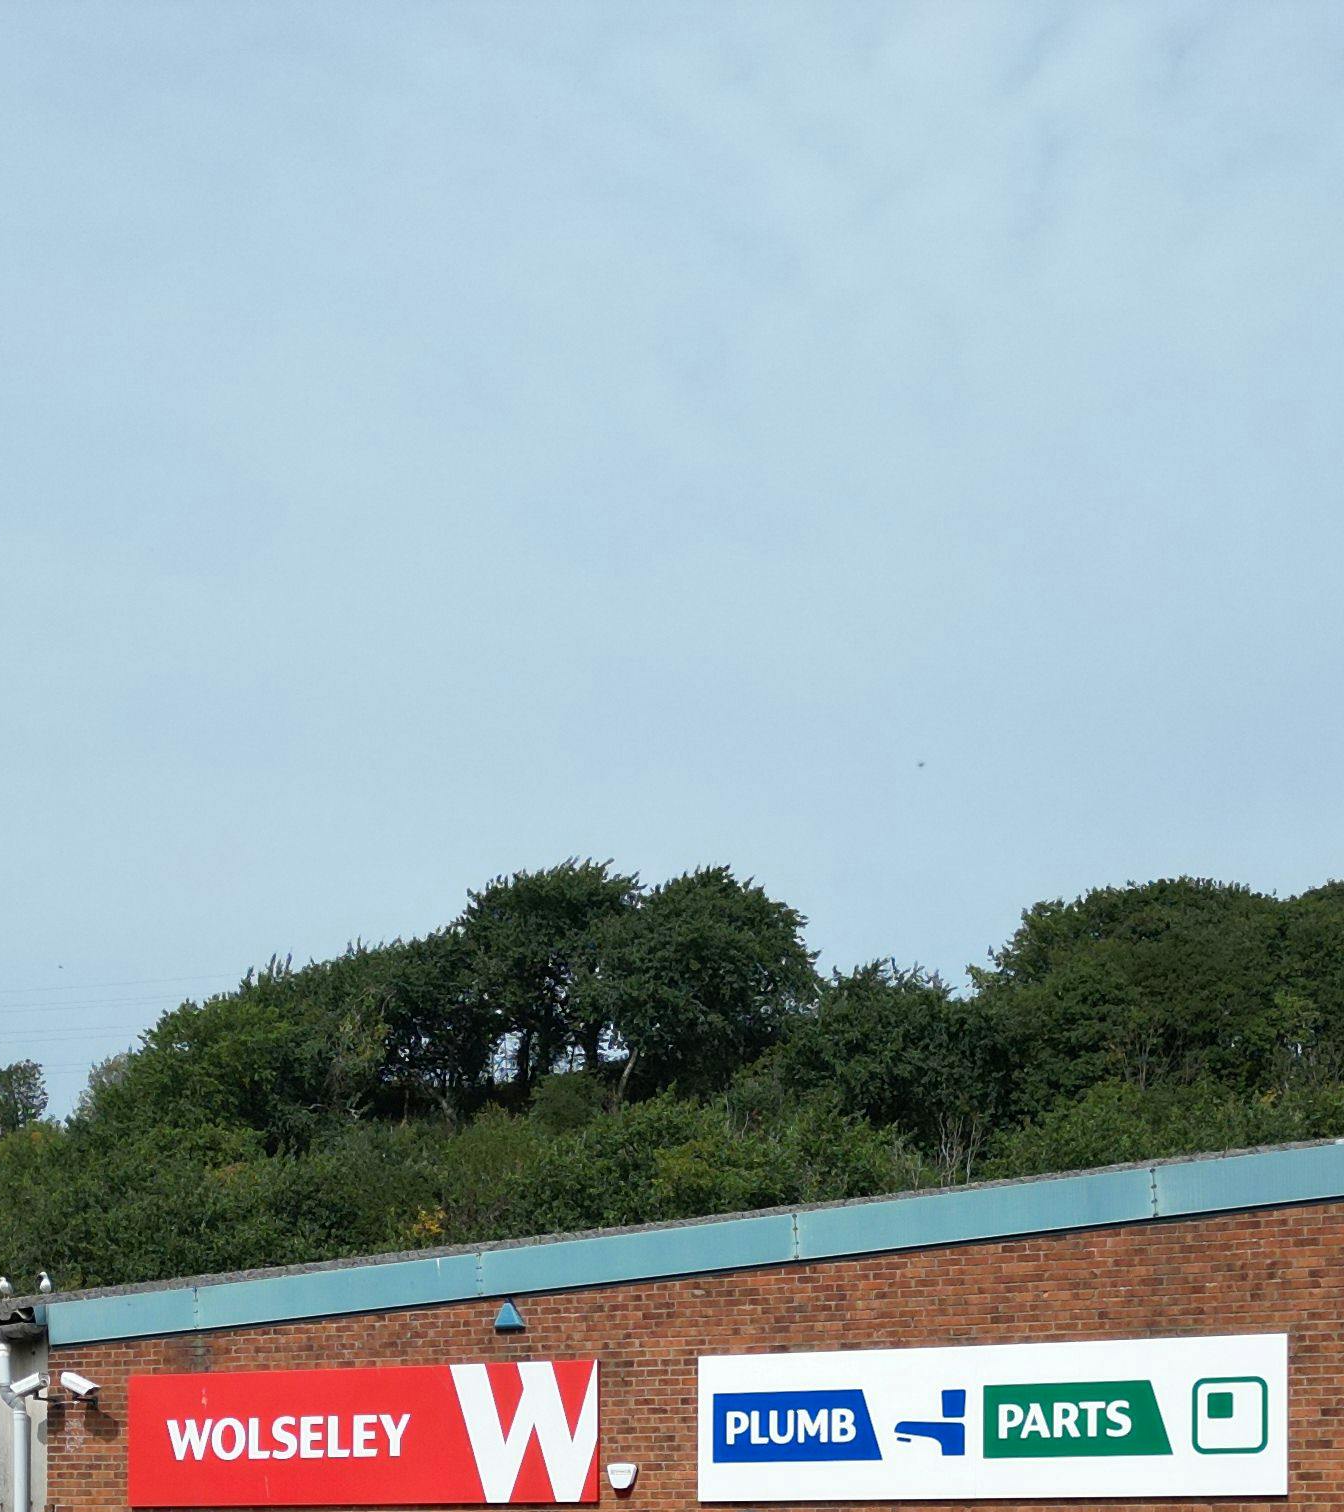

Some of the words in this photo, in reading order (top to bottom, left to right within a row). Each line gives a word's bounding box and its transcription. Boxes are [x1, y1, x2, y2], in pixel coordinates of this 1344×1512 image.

[167, 1413, 411, 1461] WOLSELEY
[449, 1360, 598, 1503] W
[725, 1407, 857, 1445] PLUMB
[997, 1400, 1133, 1439] PARTS
